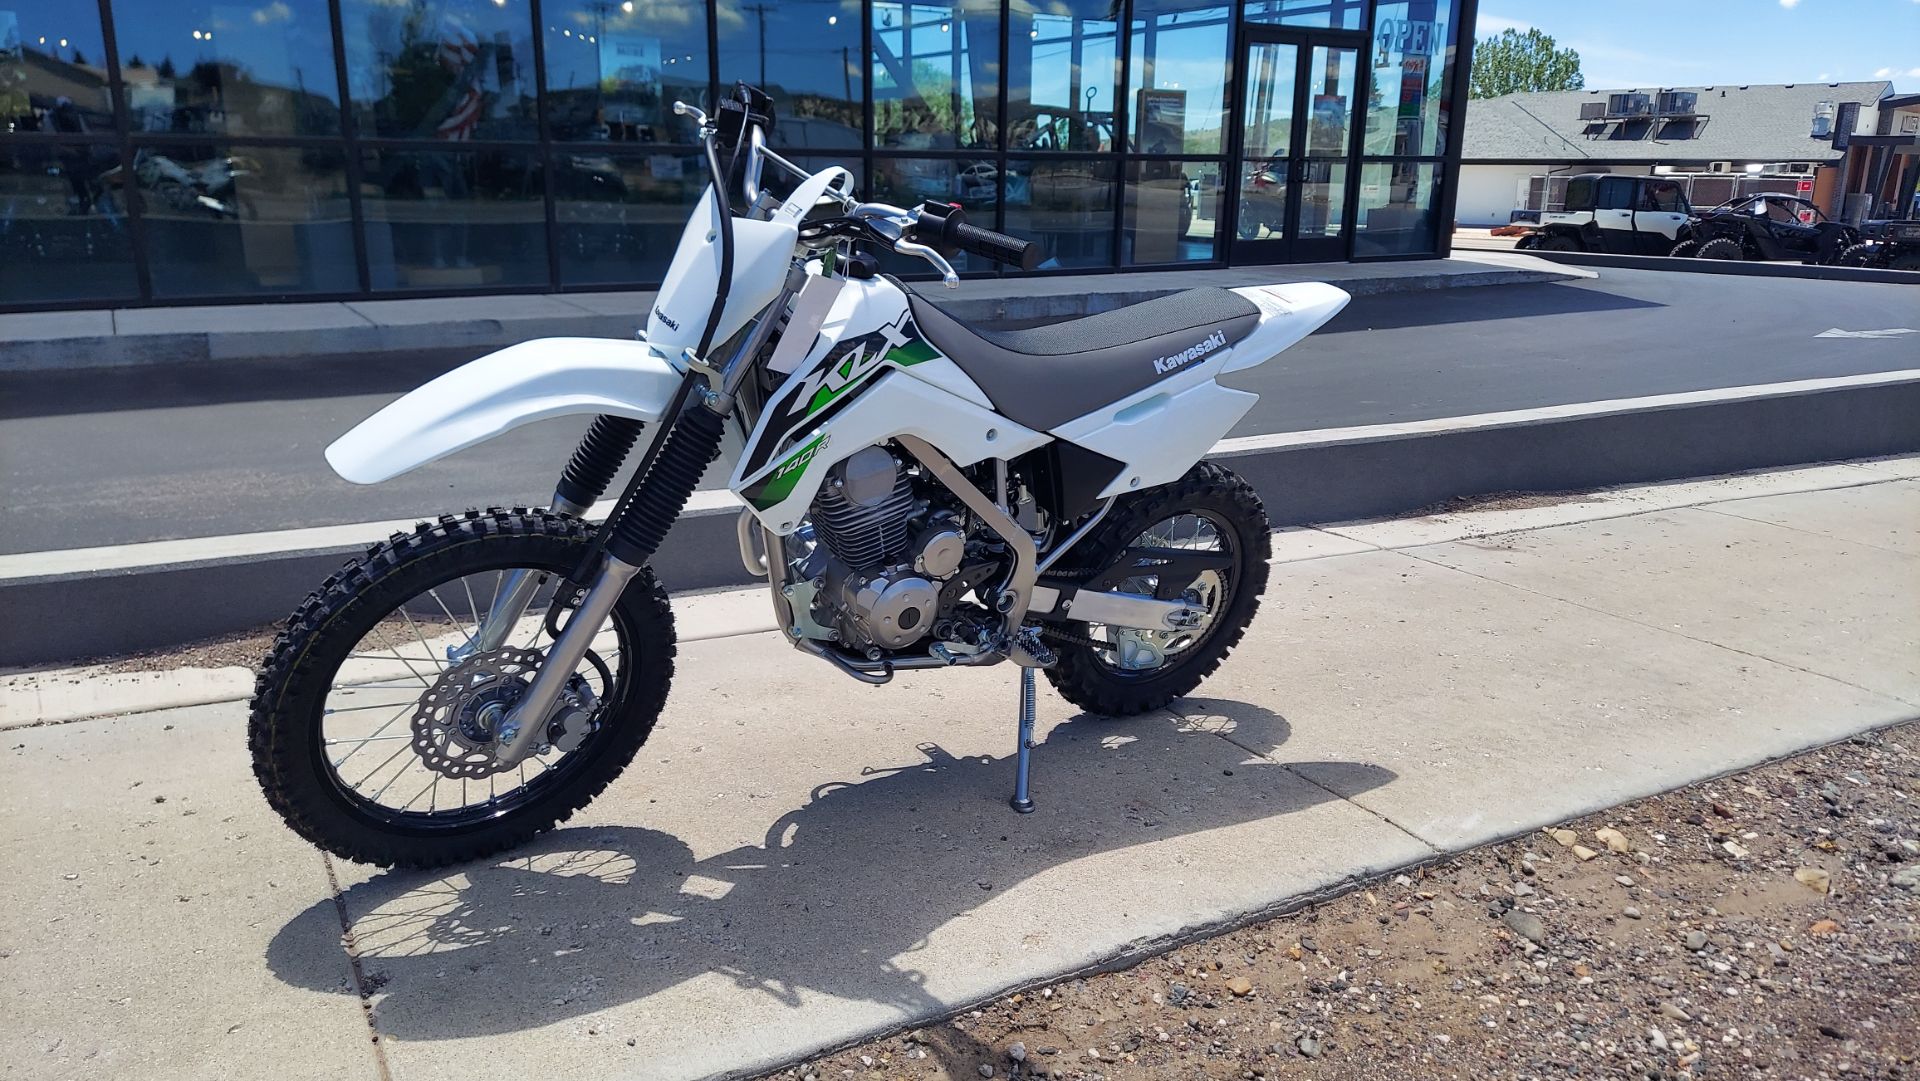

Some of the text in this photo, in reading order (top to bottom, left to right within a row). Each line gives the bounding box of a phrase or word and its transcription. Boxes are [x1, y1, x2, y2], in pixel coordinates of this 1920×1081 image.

[1379, 18, 1444, 55] OPEN
[787, 309, 912, 417] KLX
[1153, 329, 1227, 375] Kawasaki
[776, 434, 832, 480] 140R
